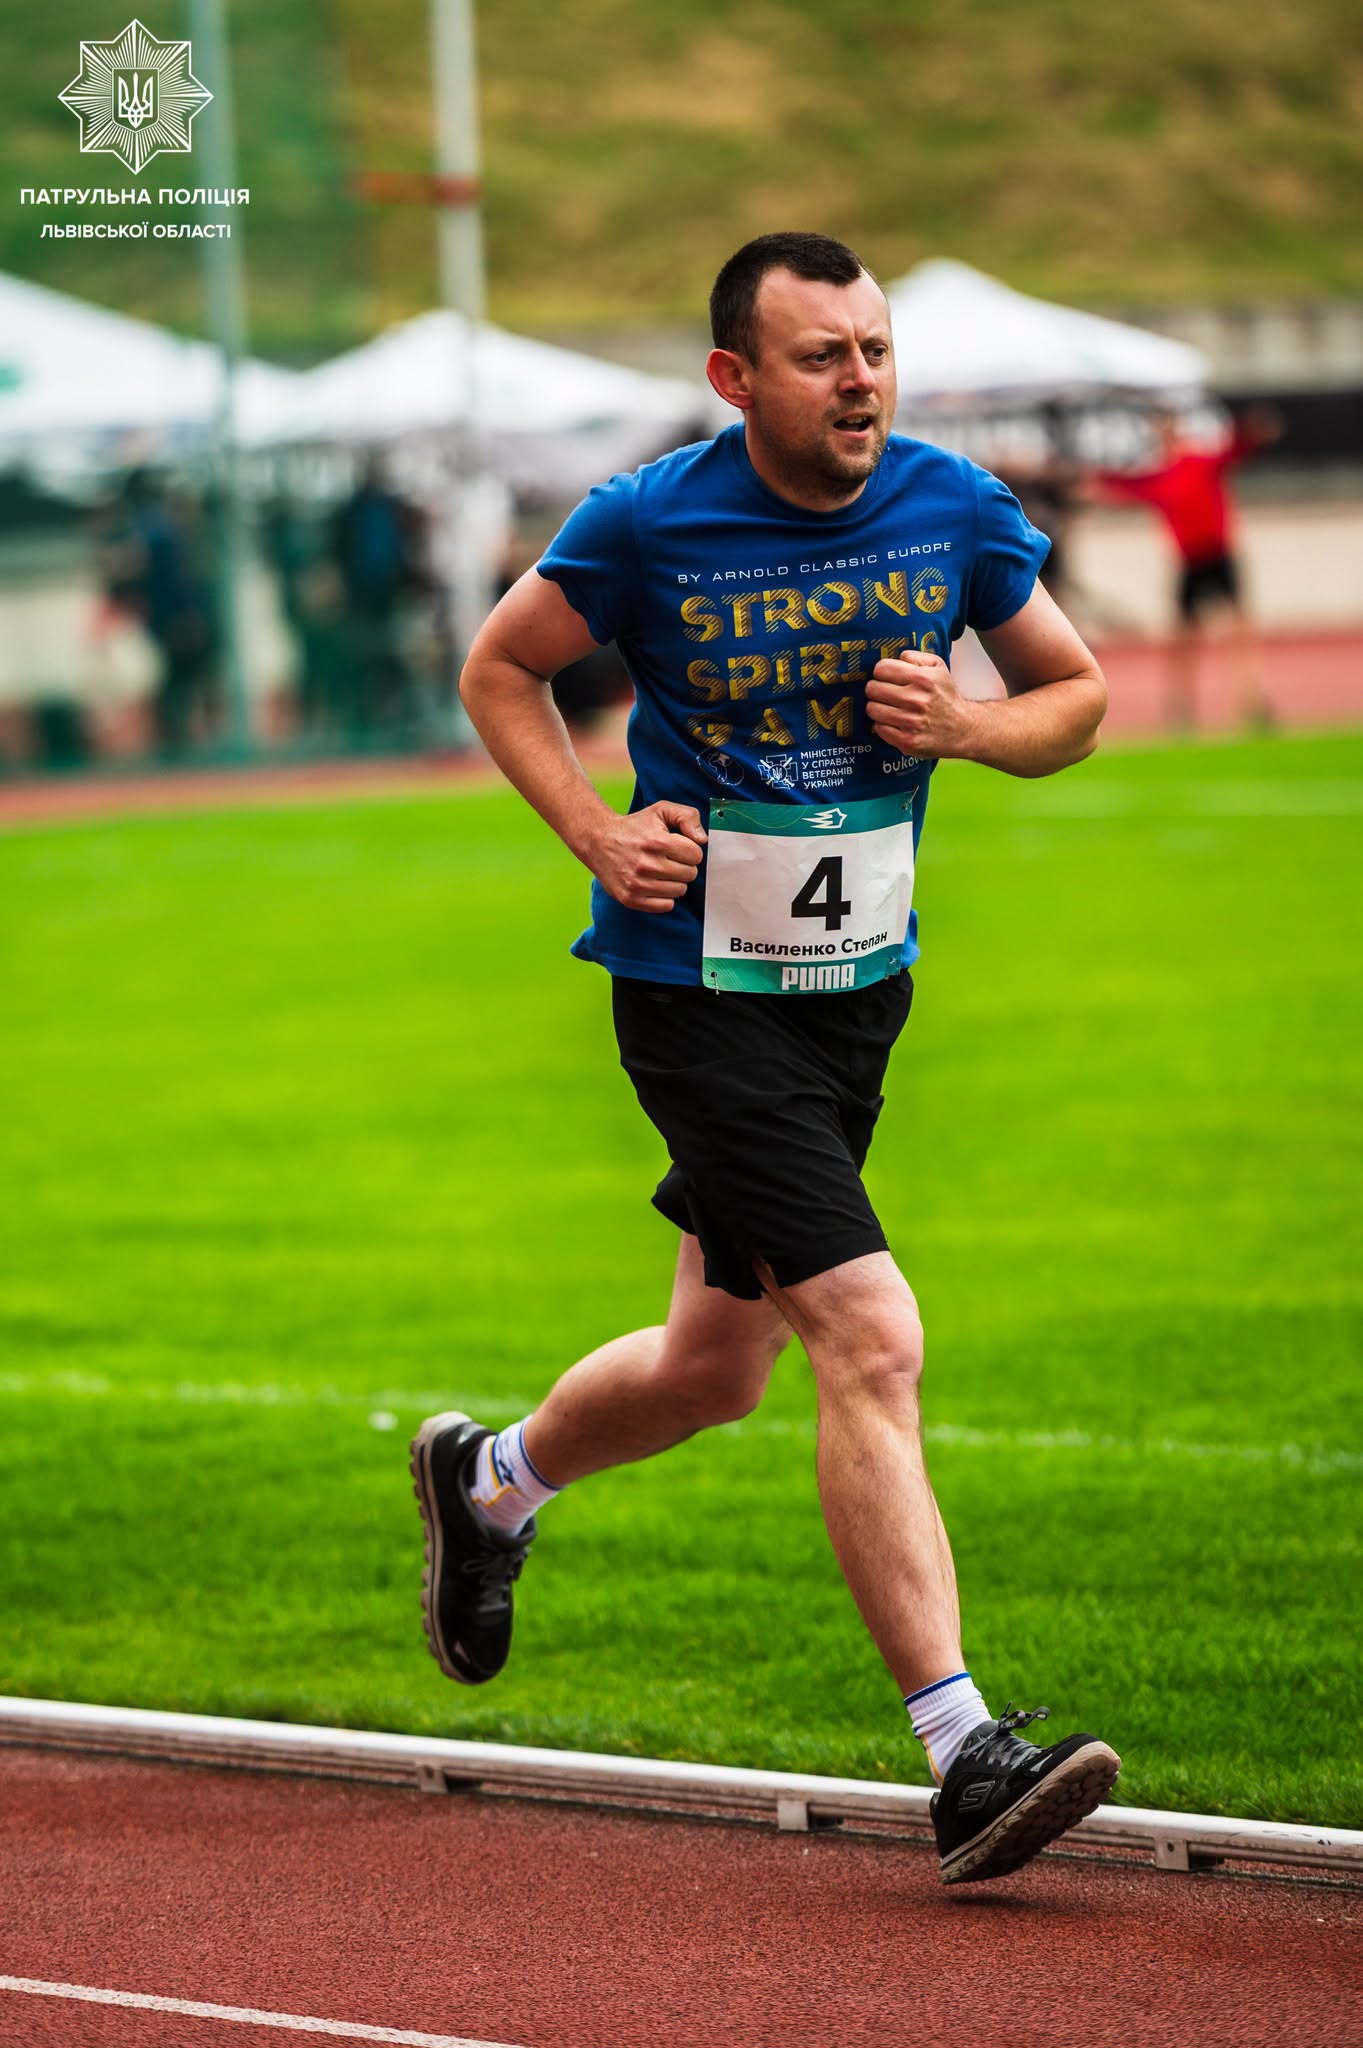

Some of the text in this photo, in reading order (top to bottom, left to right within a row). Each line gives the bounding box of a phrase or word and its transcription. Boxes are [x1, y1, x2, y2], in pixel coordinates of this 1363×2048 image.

[677, 541, 952, 584] BY ARNOLD CLASSIC EUROPE
[680, 567, 950, 643] STRONG
[686, 695, 856, 748] GAM
[800, 744, 872, 760] МІНІСТЕРСТВО
[802, 756, 856, 770] У СПРАВАХ
[882, 755, 924, 774] bukov
[802, 766, 853, 780] ВЕТЕРАНІВ
[803, 778, 844, 790] УКРАЇНИ
[791, 855, 852, 931] 4
[729, 930, 888, 957] Василенко Степан
[781, 963, 856, 991] PUMA
